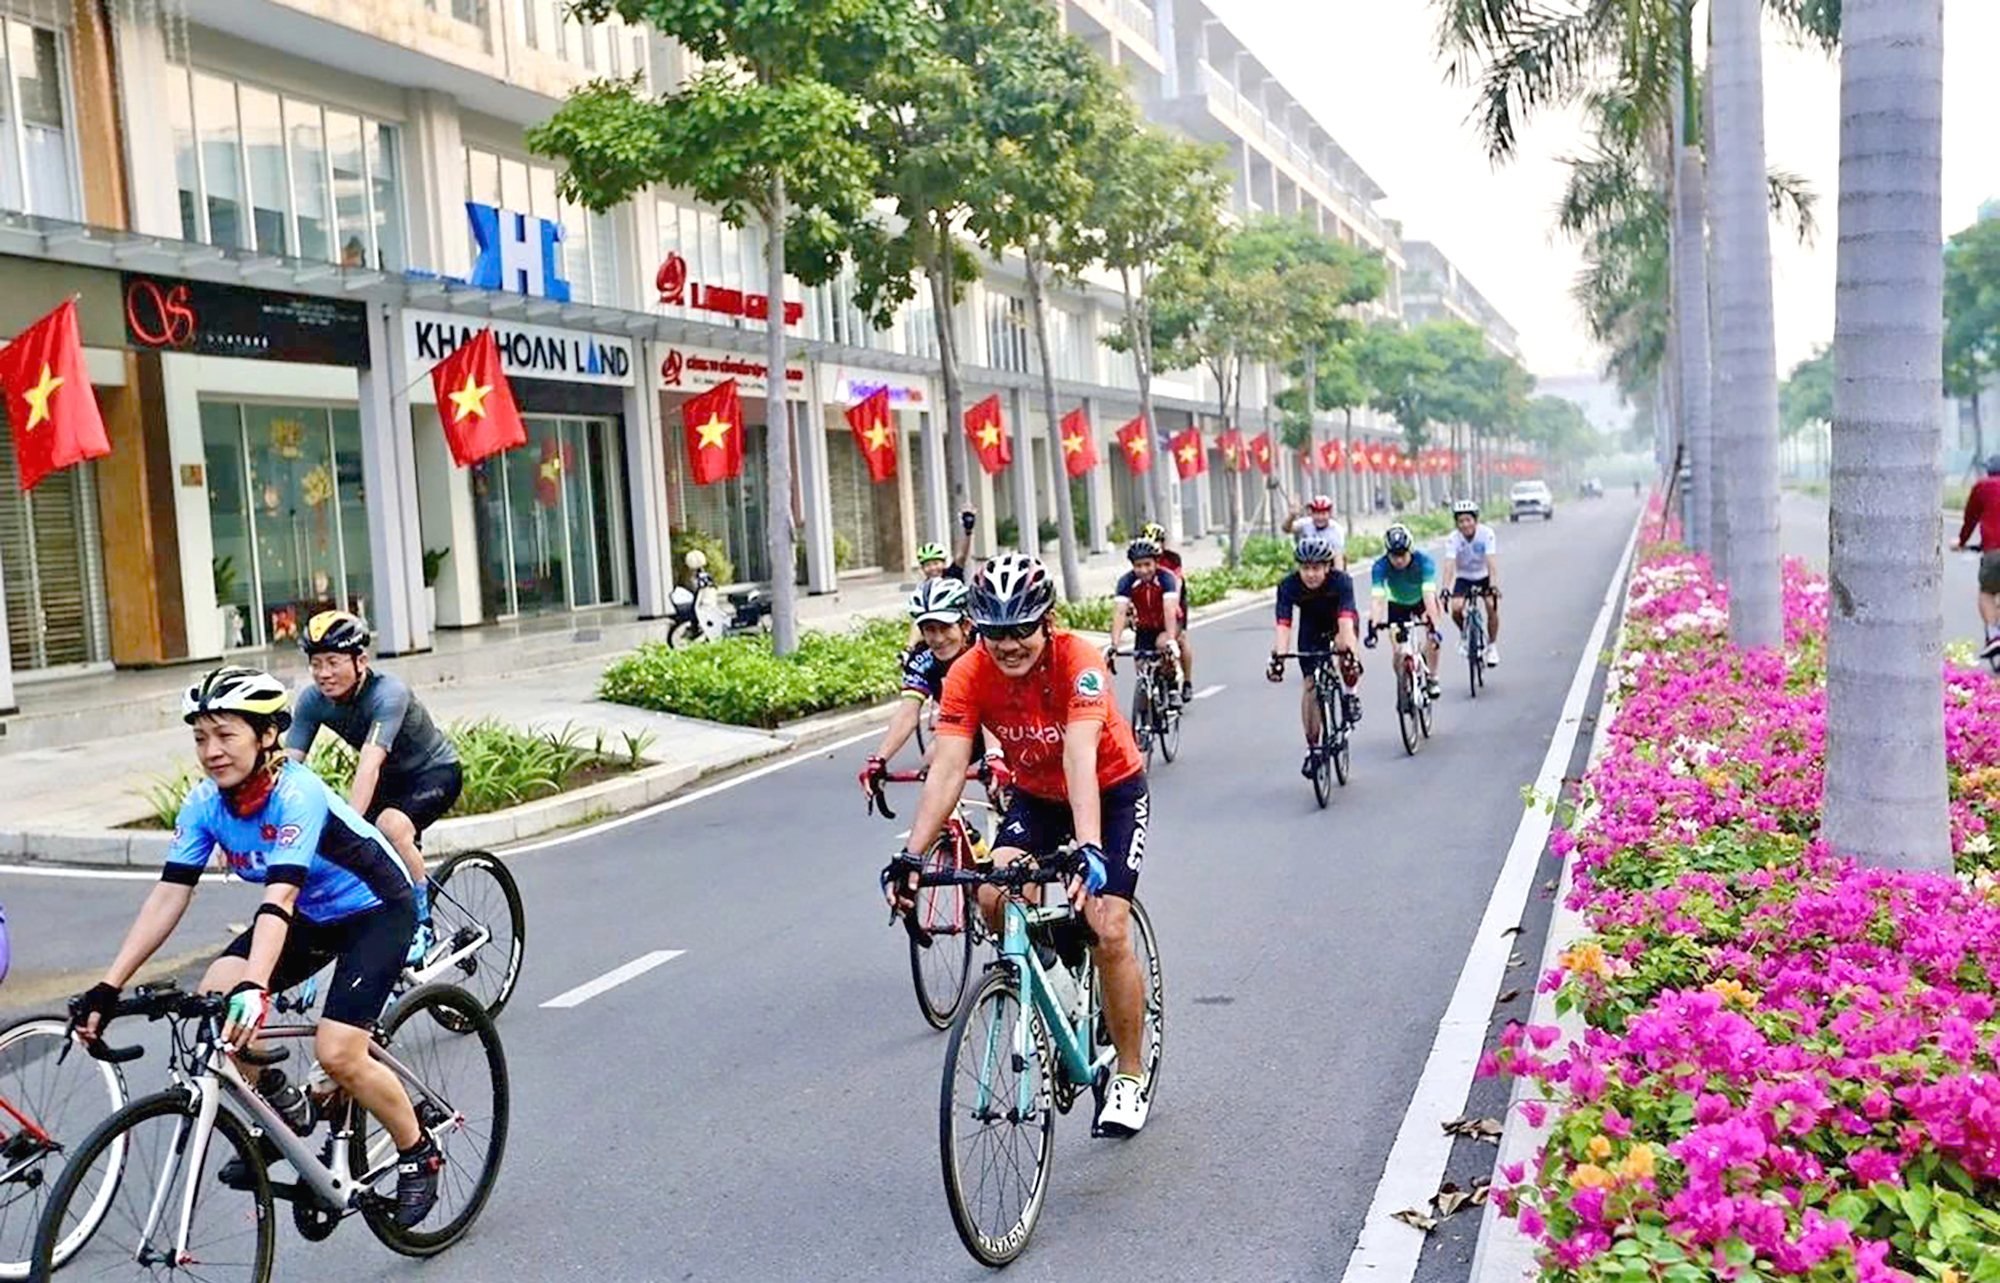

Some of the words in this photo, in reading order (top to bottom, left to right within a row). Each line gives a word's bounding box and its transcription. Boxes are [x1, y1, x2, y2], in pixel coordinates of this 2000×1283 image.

[415, 321, 484, 360] KHA
[574, 335, 630, 377] LAND
[1127, 793, 1148, 873] STRAVA
